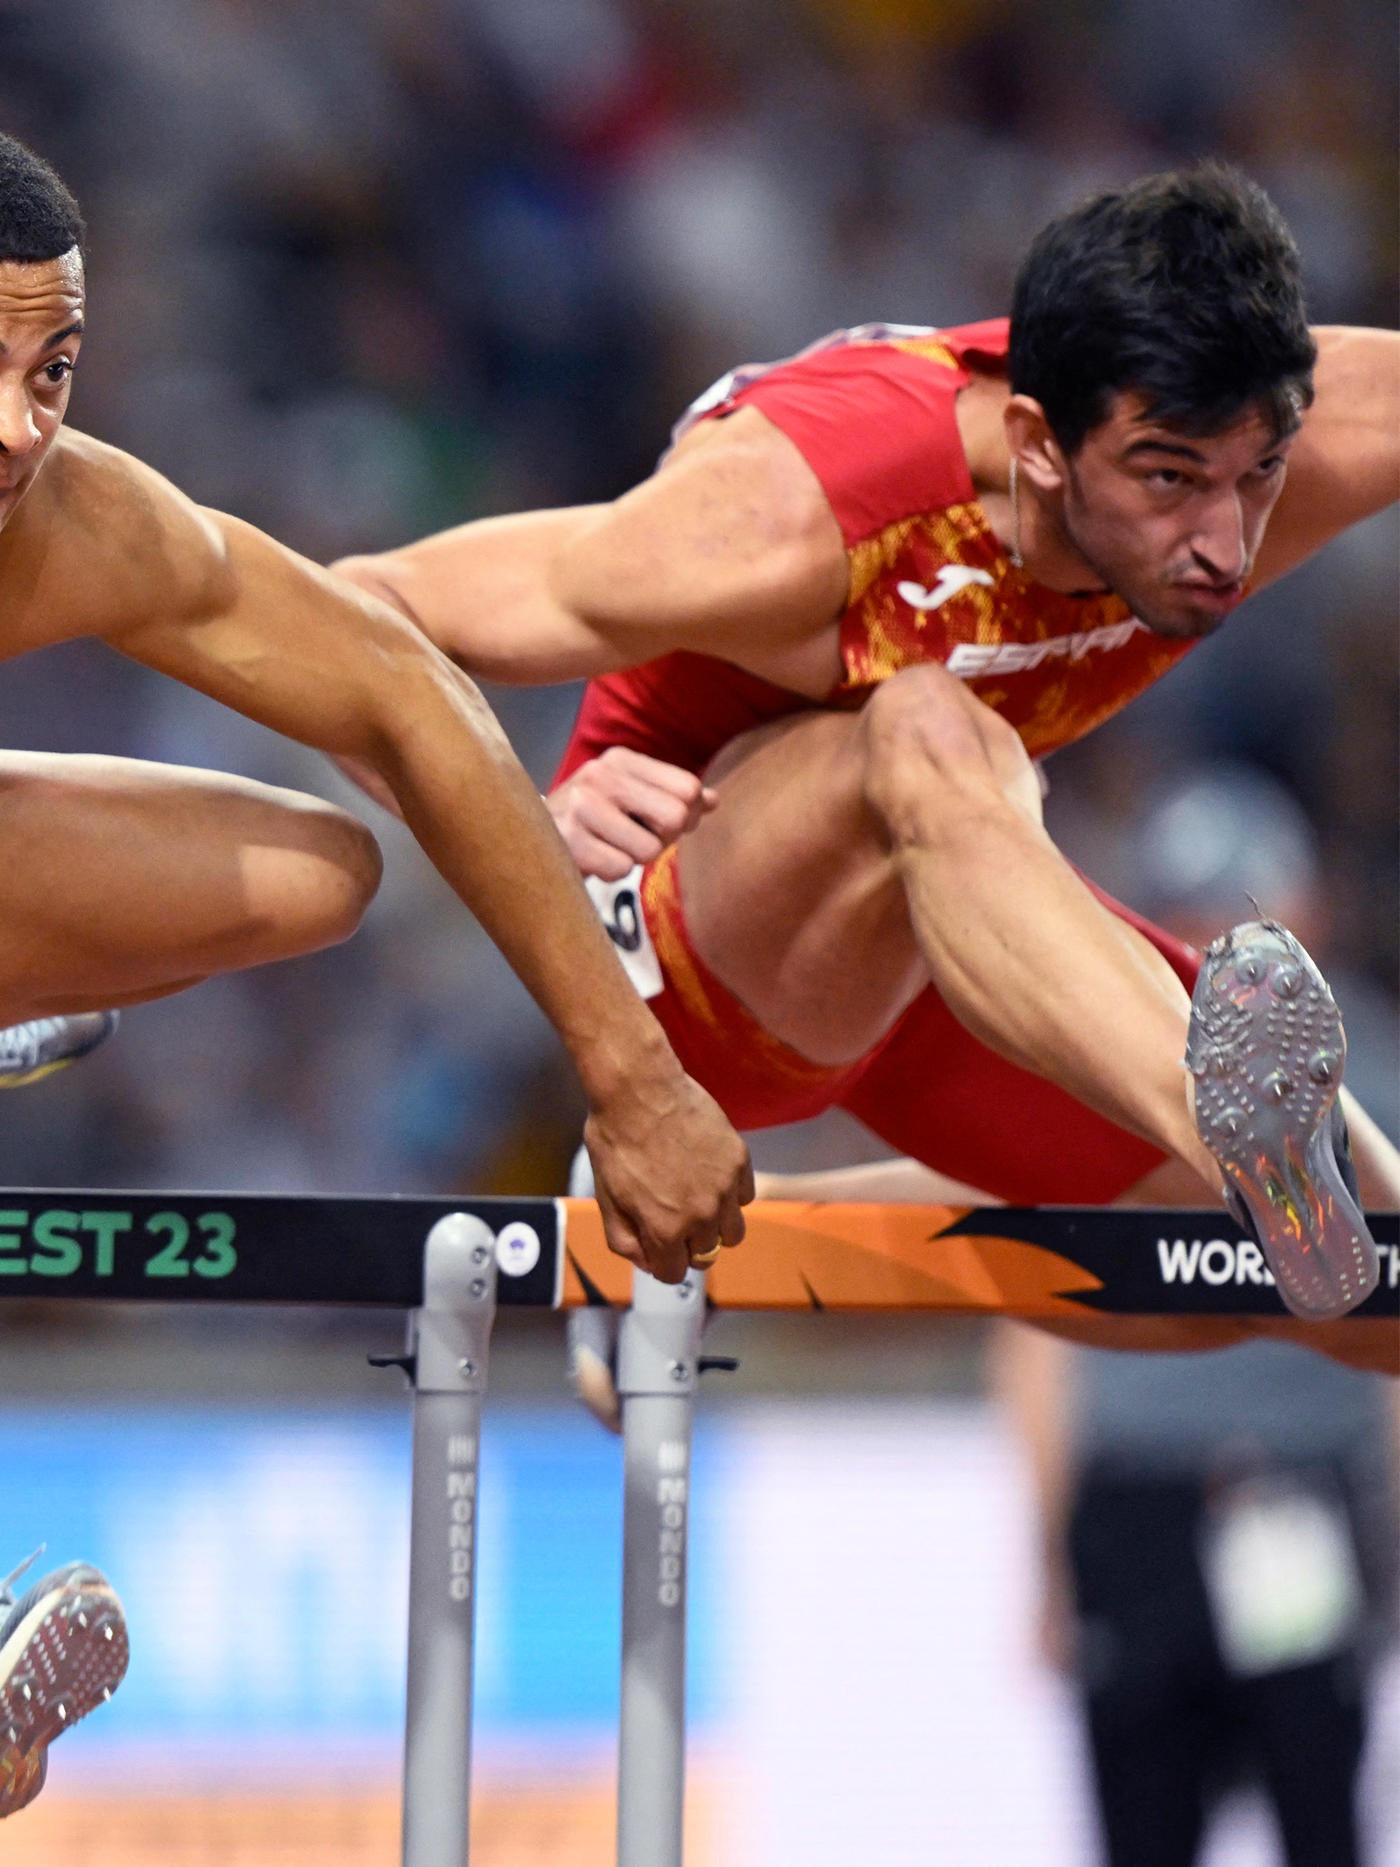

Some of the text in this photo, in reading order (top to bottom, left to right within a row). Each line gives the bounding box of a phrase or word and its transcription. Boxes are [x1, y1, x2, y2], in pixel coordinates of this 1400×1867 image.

[144, 1211, 238, 1278] 23
[447, 1471, 475, 1600] MONDO
[657, 1477, 686, 1608] MONDO
